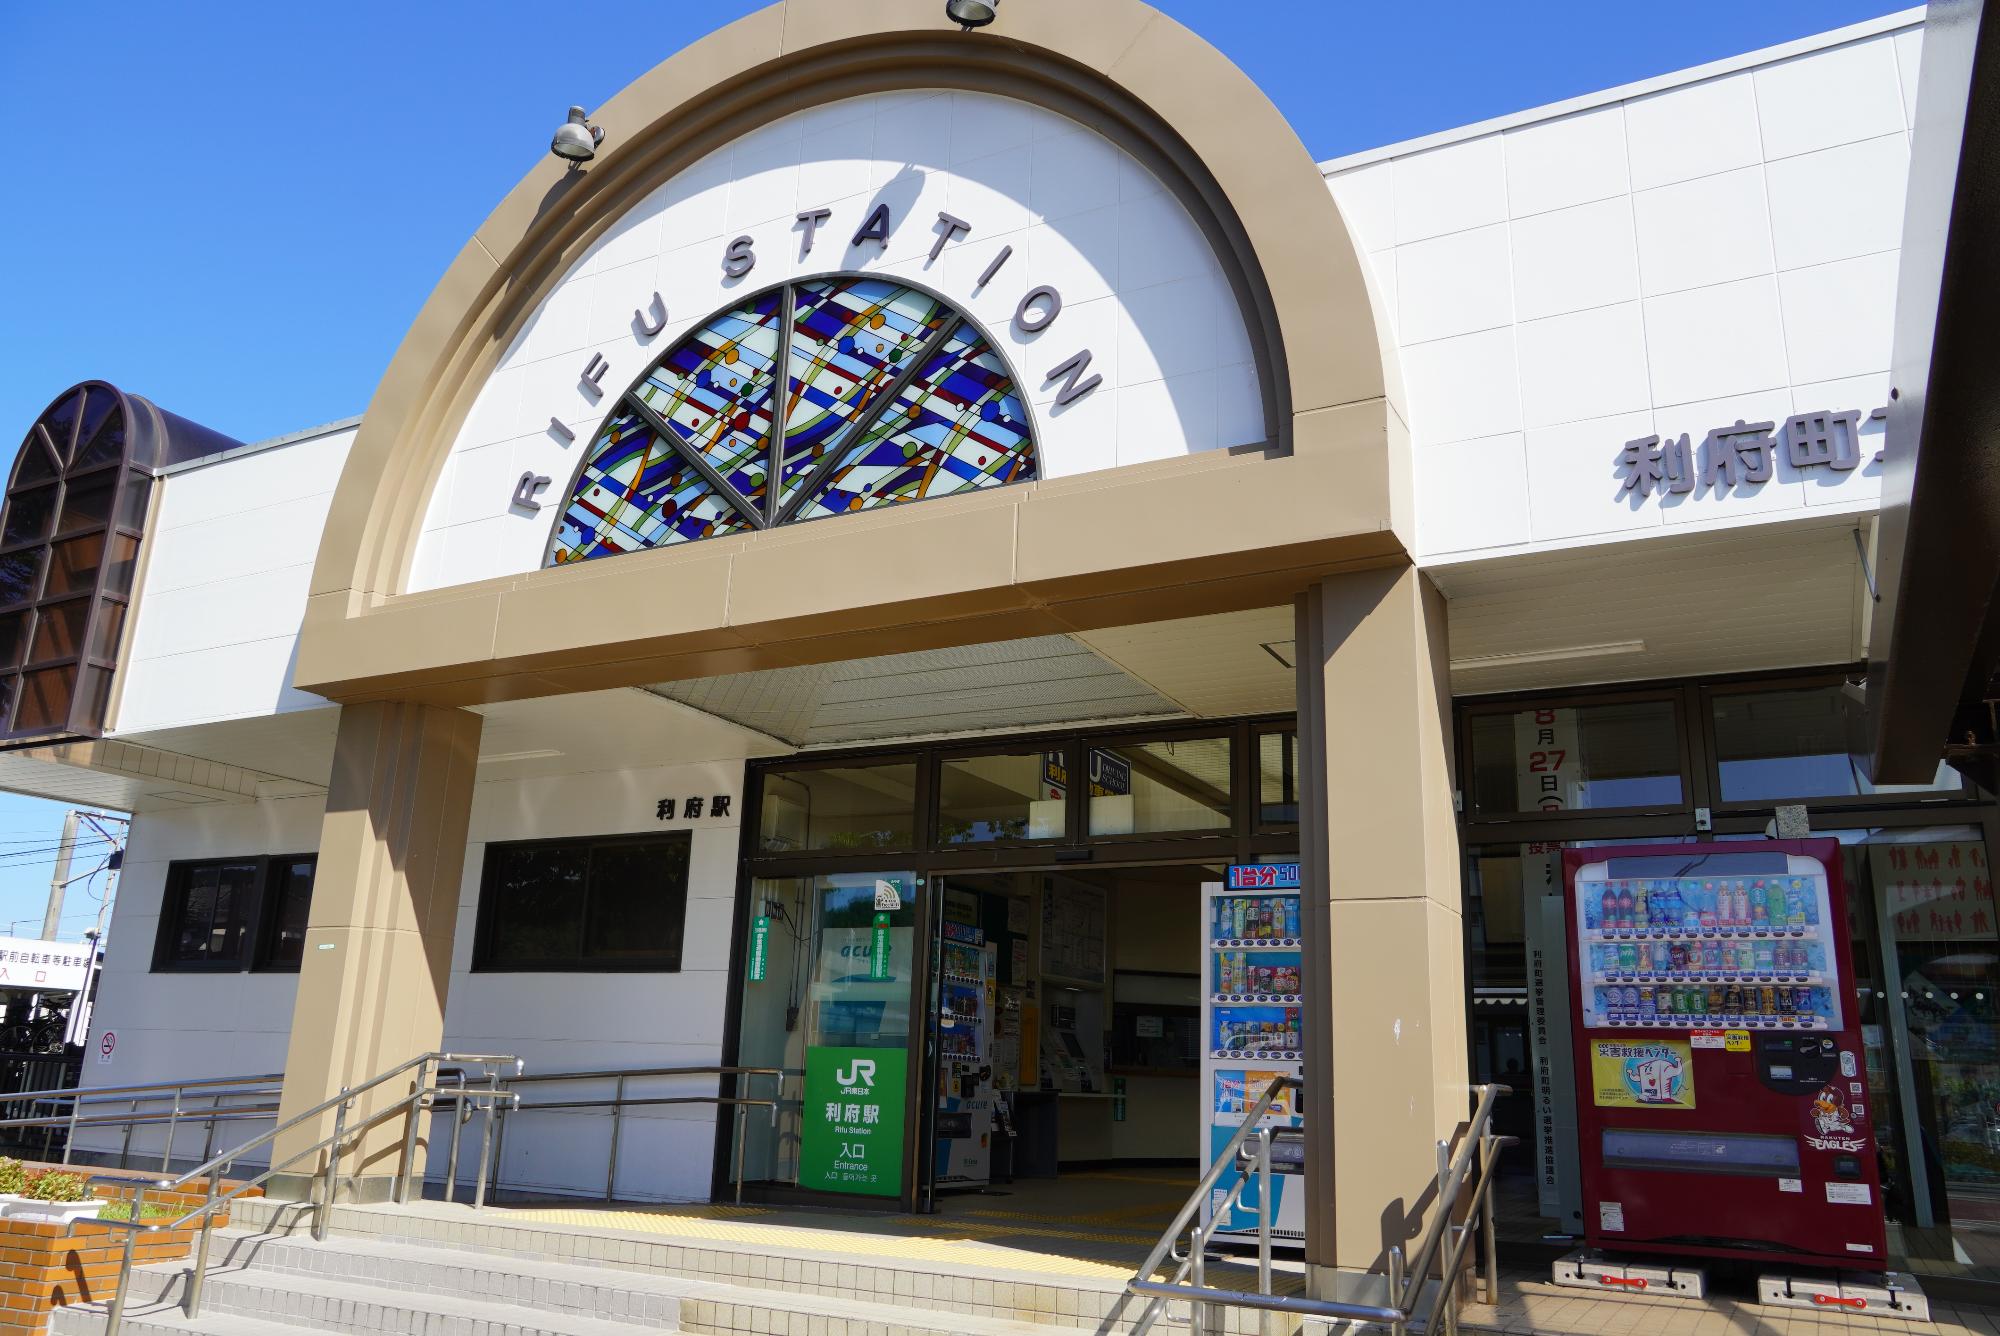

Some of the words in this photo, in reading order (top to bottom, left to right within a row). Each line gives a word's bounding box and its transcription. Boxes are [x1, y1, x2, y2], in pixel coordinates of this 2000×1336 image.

[510, 291, 669, 512] RIFU
[724, 202, 1104, 406] STATION
[1625, 407, 1887, 497] 利府町
[656, 796, 731, 820] 利府駅
[836, 1059, 876, 1086] JR
[840, 1087, 870, 1095] JR東日本
[825, 1102, 880, 1124] 利府駅
[834, 1126, 848, 1134] Rifu
[849, 1126, 872, 1135] Station
[840, 1142, 865, 1159] 入口
[1814, 1139, 1858, 1152] EAGLES
[834, 1160, 868, 1172] Entrance
